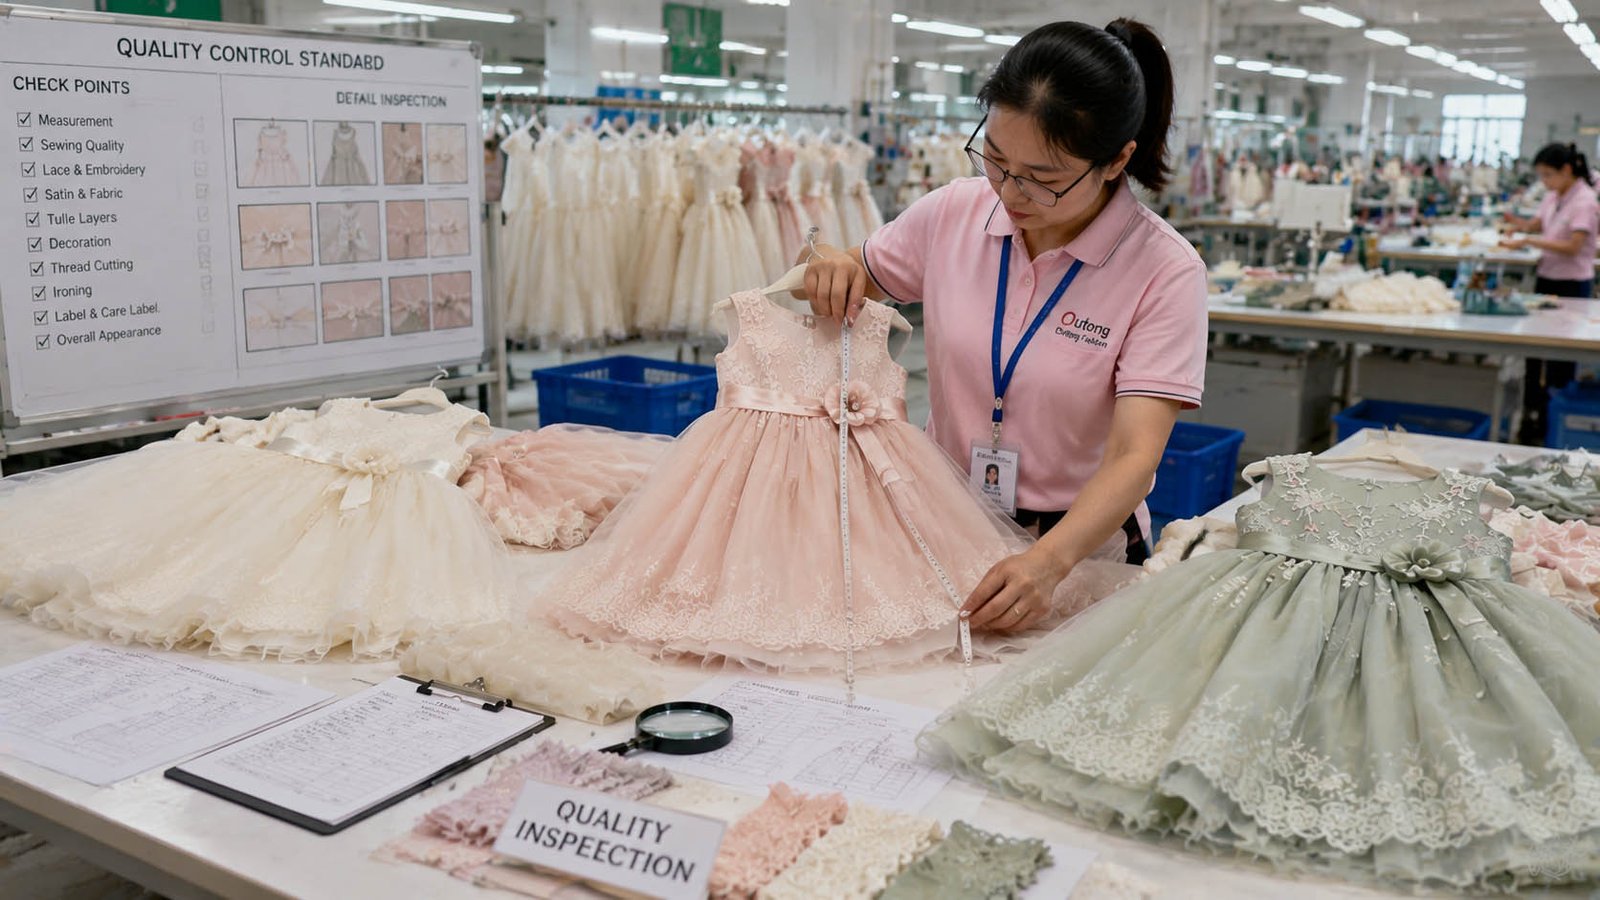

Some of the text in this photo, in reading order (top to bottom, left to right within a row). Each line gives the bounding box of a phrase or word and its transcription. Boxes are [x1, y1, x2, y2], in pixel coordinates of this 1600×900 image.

[117, 38, 202, 60] QUALITY
[210, 45, 293, 65] CONTROL
[13, 76, 130, 94] CHECK POINTS
[381, 94, 447, 107] INSPECTION
[39, 114, 113, 127] Measurement
[41, 139, 124, 153] Sewing Quality
[43, 163, 146, 177] Lace & Embroidery
[45, 188, 123, 200] Satin & Fabric
[47, 213, 117, 226] Tulle Layers
[49, 236, 111, 249] Decoration
[50, 259, 133, 274] Thread Cutting
[53, 285, 92, 298] Ironing
[55, 309, 86, 322] Label
[90, 308, 98, 319] &
[101, 307, 126, 318] Care
[57, 327, 161, 345] Overall Appearance
[556, 800, 672, 844] QUALITY
[515, 819, 696, 882] INSPEECTION
